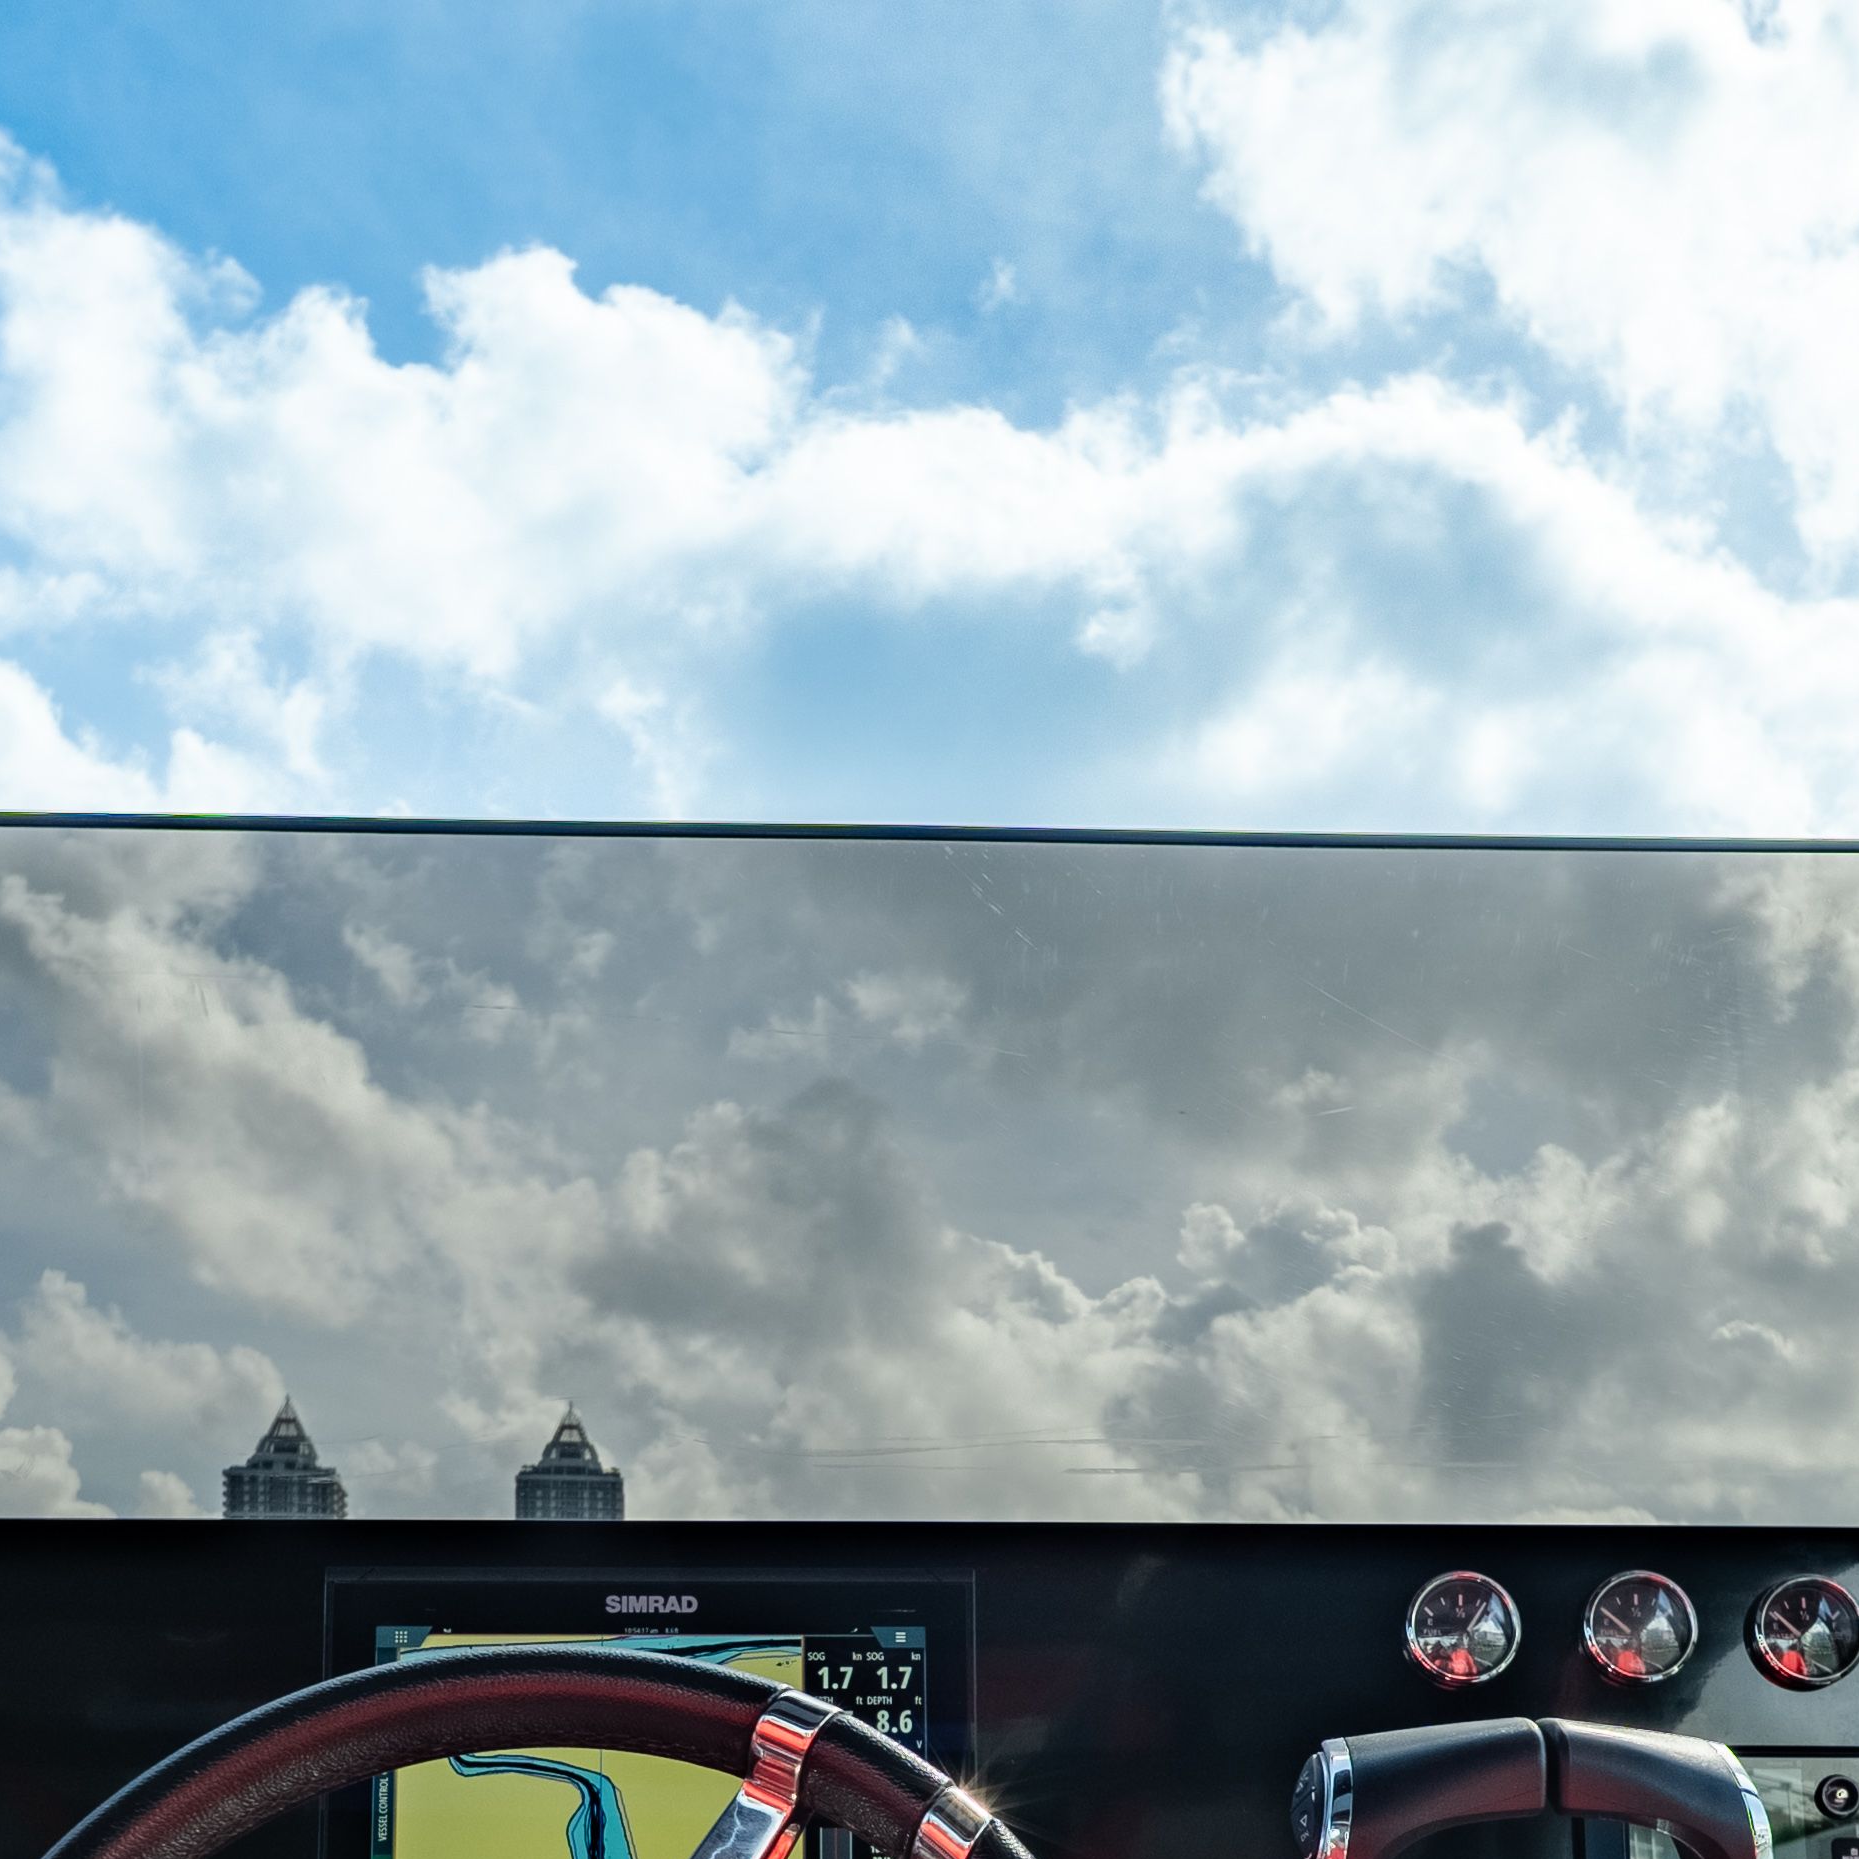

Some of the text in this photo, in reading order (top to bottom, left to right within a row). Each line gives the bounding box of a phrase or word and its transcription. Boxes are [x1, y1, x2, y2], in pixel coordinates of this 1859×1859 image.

[604, 1595, 698, 1613] SIMRAD
[807, 1652, 862, 1660] SOG kn
[866, 1652, 921, 1660] SOG kn
[817, 1666, 853, 1689] 1.7
[876, 1666, 912, 1689] 1.7
[856, 1696, 863, 1705] ft
[866, 1696, 922, 1705] DEPTH ft
[876, 1710, 913, 1733] 8.6
